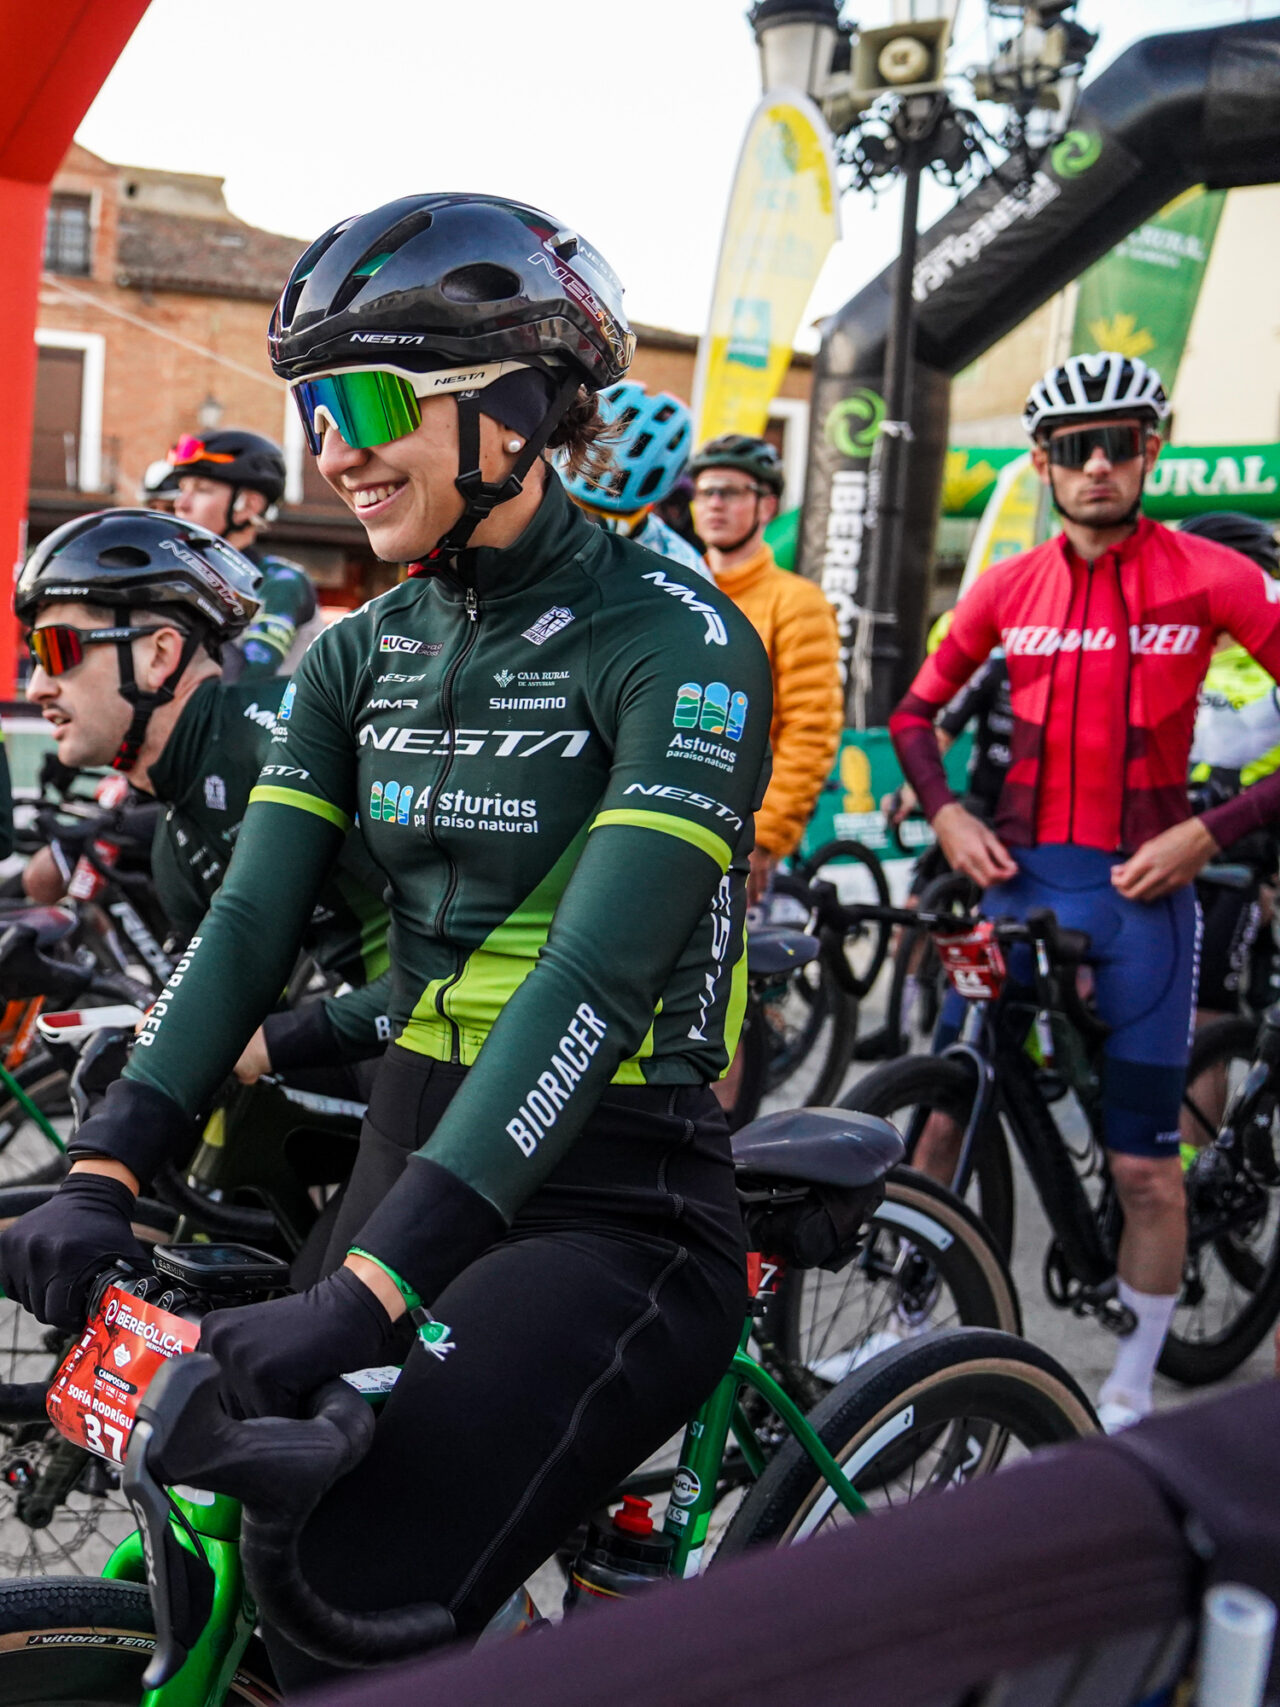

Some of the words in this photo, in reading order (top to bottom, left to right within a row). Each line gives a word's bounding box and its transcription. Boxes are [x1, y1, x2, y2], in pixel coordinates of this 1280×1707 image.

[349, 333, 425, 345] NESTA
[434, 371, 486, 386] NESTA
[642, 571, 729, 646] MMR
[388, 637, 419, 653] UCI
[377, 673, 427, 683] NESTA
[517, 672, 539, 680] CAJA
[542, 671, 570, 679] RURAL
[367, 699, 419, 709] MMR
[489, 697, 567, 710] SHIMANO
[244, 702, 278, 731] MM
[359, 723, 590, 759] NESTA
[670, 733, 737, 764] Asturias
[666, 749, 701, 765] paraíso
[701, 756, 734, 773] natural
[414, 785, 537, 819] Asturias
[623, 783, 744, 832] NESTA
[478, 817, 539, 834] natural
[135, 936, 203, 1047] BIORACER
[506, 1002, 607, 1158] BIORACER
[158, 1260, 185, 1277] GARMIN
[116, 1309, 184, 1355] IBEREÓLICA
[99, 1369, 130, 1392] CAMPOS360
[67, 1384, 92, 1407] SOFÍA
[92, 1398, 134, 1430] RODRÍGU
[84, 1413, 125, 1463] 37
[690, 1421, 705, 1439] S1
[669, 1508, 684, 1522] XS
[41, 1634, 108, 1644] vittoria
